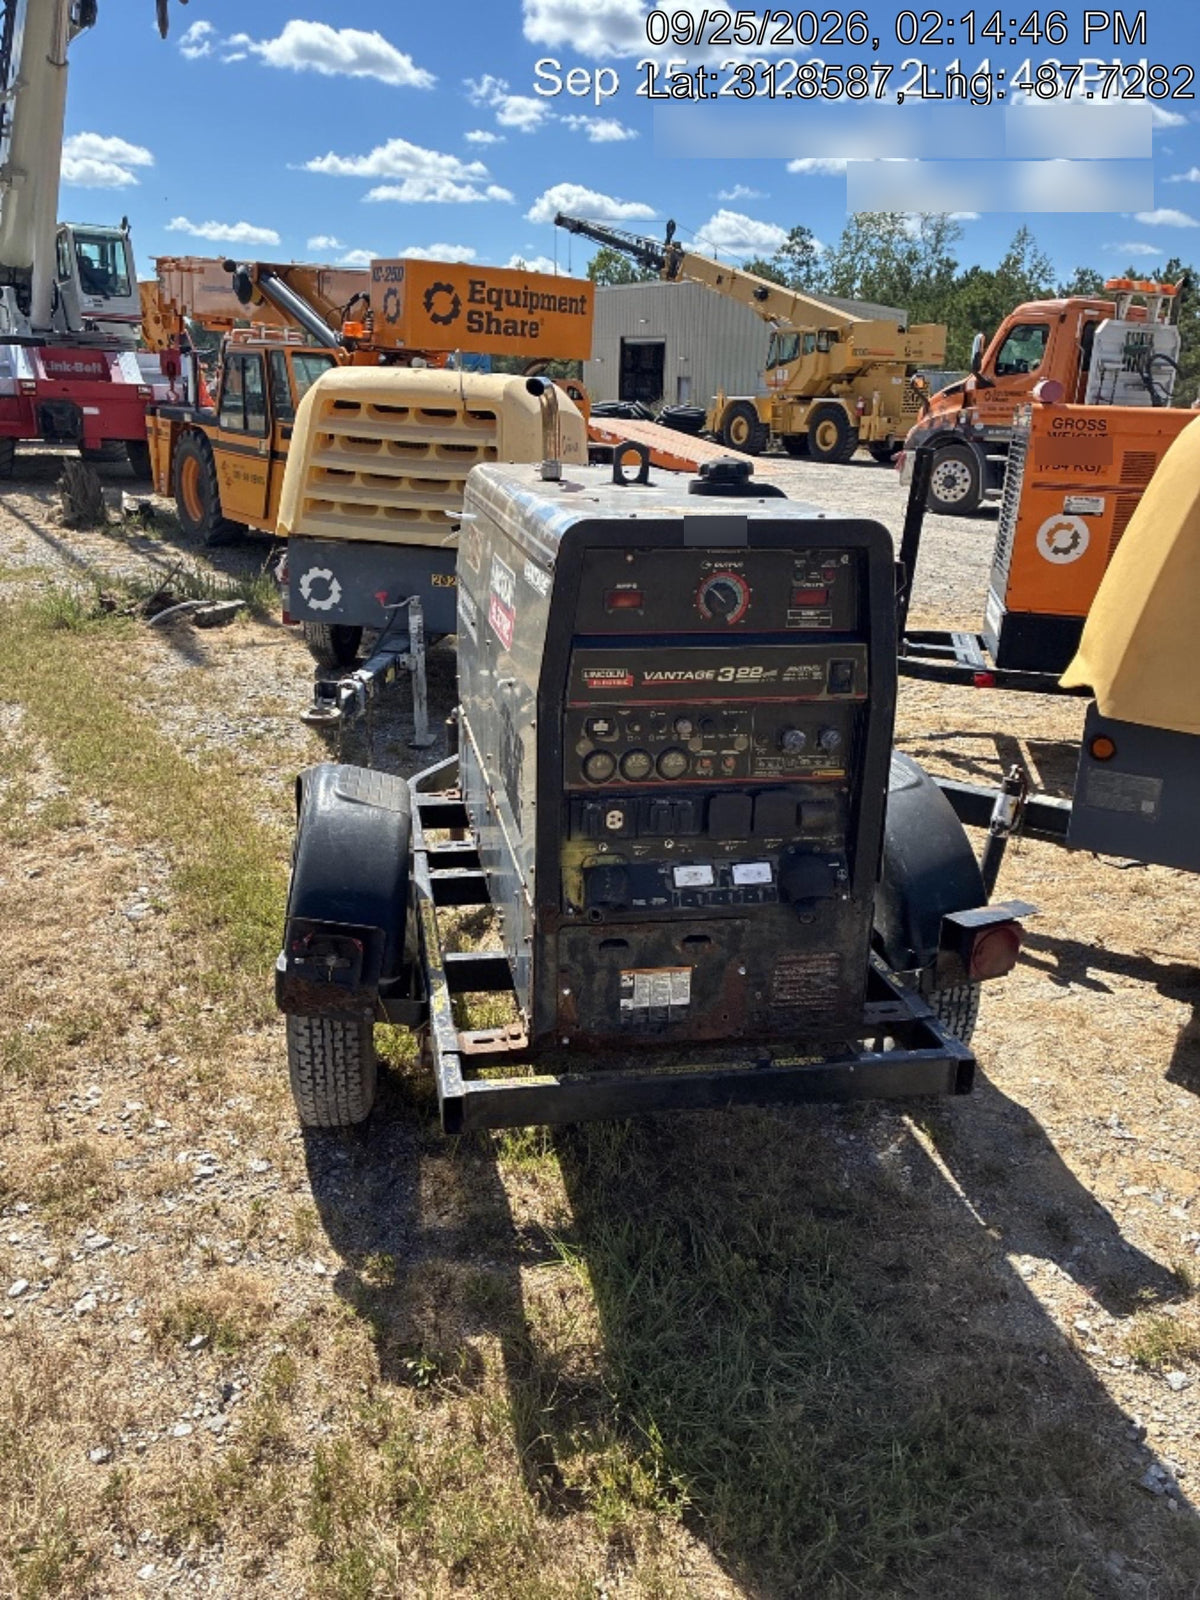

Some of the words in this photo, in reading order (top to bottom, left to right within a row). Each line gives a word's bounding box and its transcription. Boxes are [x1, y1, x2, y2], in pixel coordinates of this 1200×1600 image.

[467, 279, 588, 316] Equipment
[466, 310, 540, 338] Share
[1052, 417, 1108, 431] GROSS
[584, 670, 625, 678] LINCOLN
[643, 670, 716, 681] VANTAGE
[717, 666, 764, 682] 322
